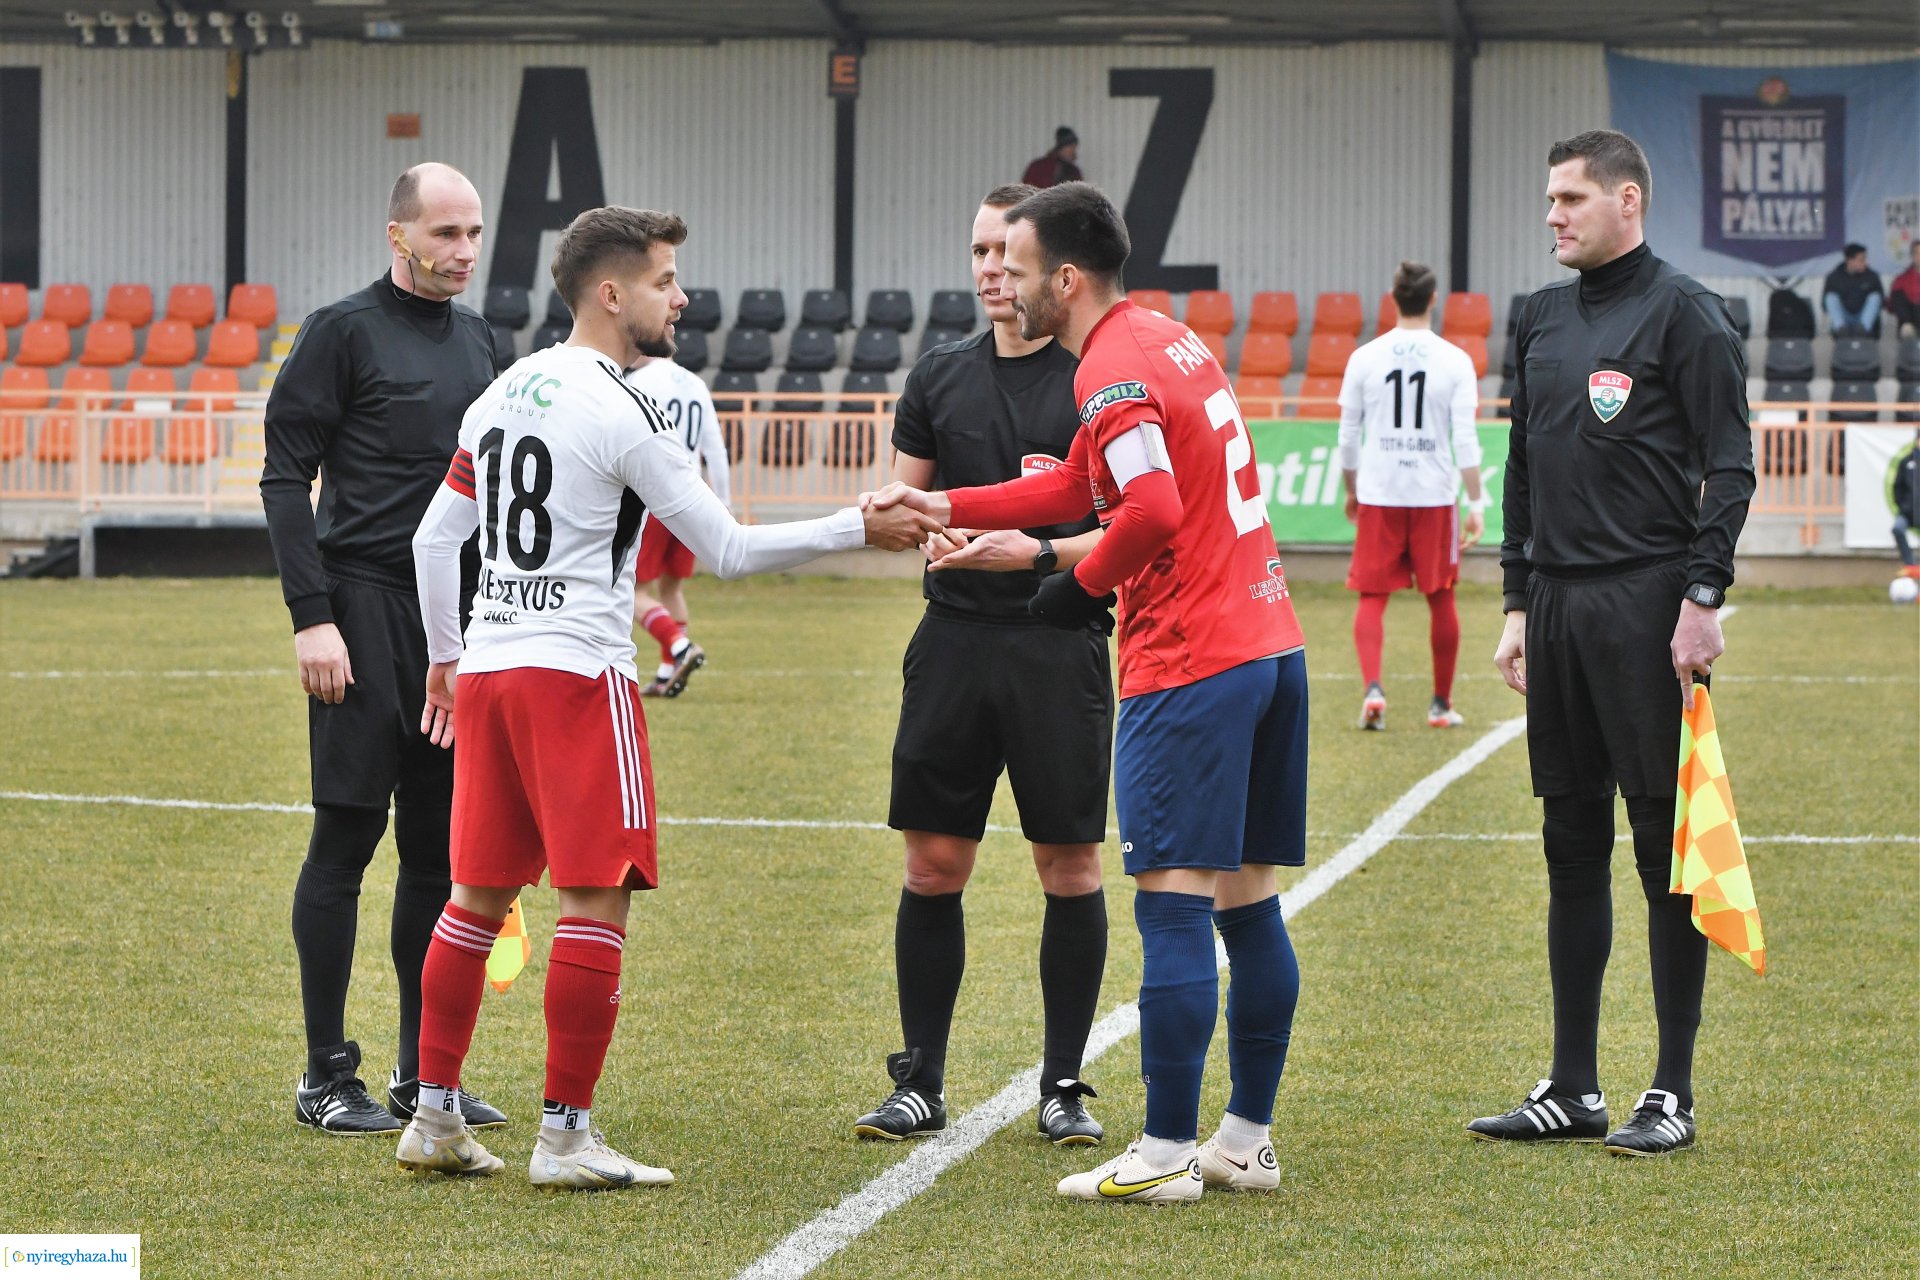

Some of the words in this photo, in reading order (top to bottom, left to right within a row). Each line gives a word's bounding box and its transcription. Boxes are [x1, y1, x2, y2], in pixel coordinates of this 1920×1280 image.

[832, 55, 857, 84] E
[486, 67, 607, 289] A
[1108, 67, 1219, 292] Z
[1722, 140, 1825, 193] NEM
[1722, 194, 1824, 234] PÁLYA!
[1385, 369, 1426, 430] 11
[1599, 376, 1622, 386] MLSZ
[500, 403, 546, 420] GROUP
[667, 398, 702, 452] 20
[478, 426, 553, 571] 18
